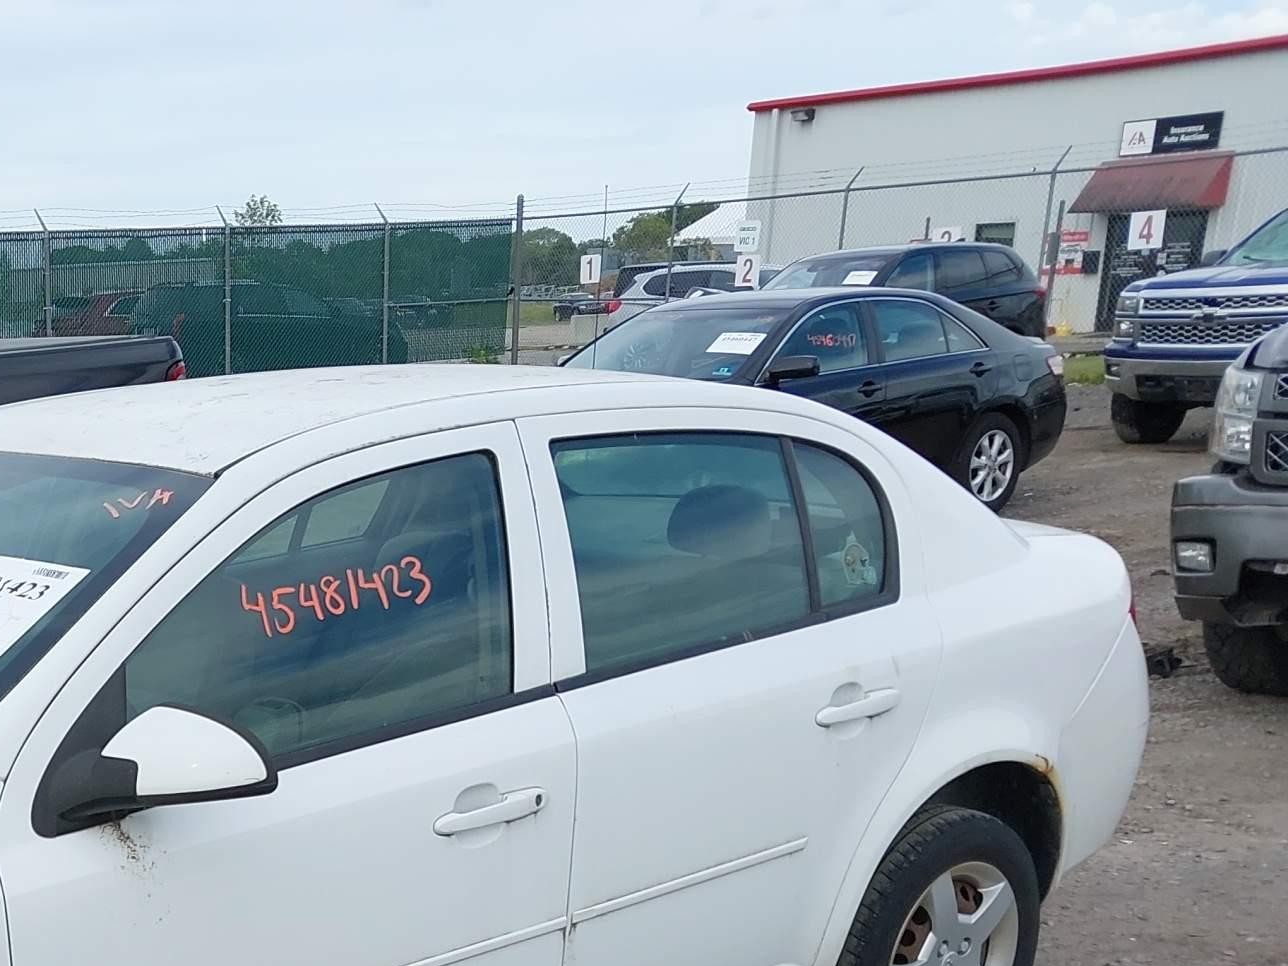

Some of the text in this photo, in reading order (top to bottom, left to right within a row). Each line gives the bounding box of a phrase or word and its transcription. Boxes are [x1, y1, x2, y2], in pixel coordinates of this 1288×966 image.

[1138, 215, 1154, 245] 4
[586, 257, 593, 281] 1
[742, 258, 753, 283] 2
[241, 555, 432, 638] 45481423
